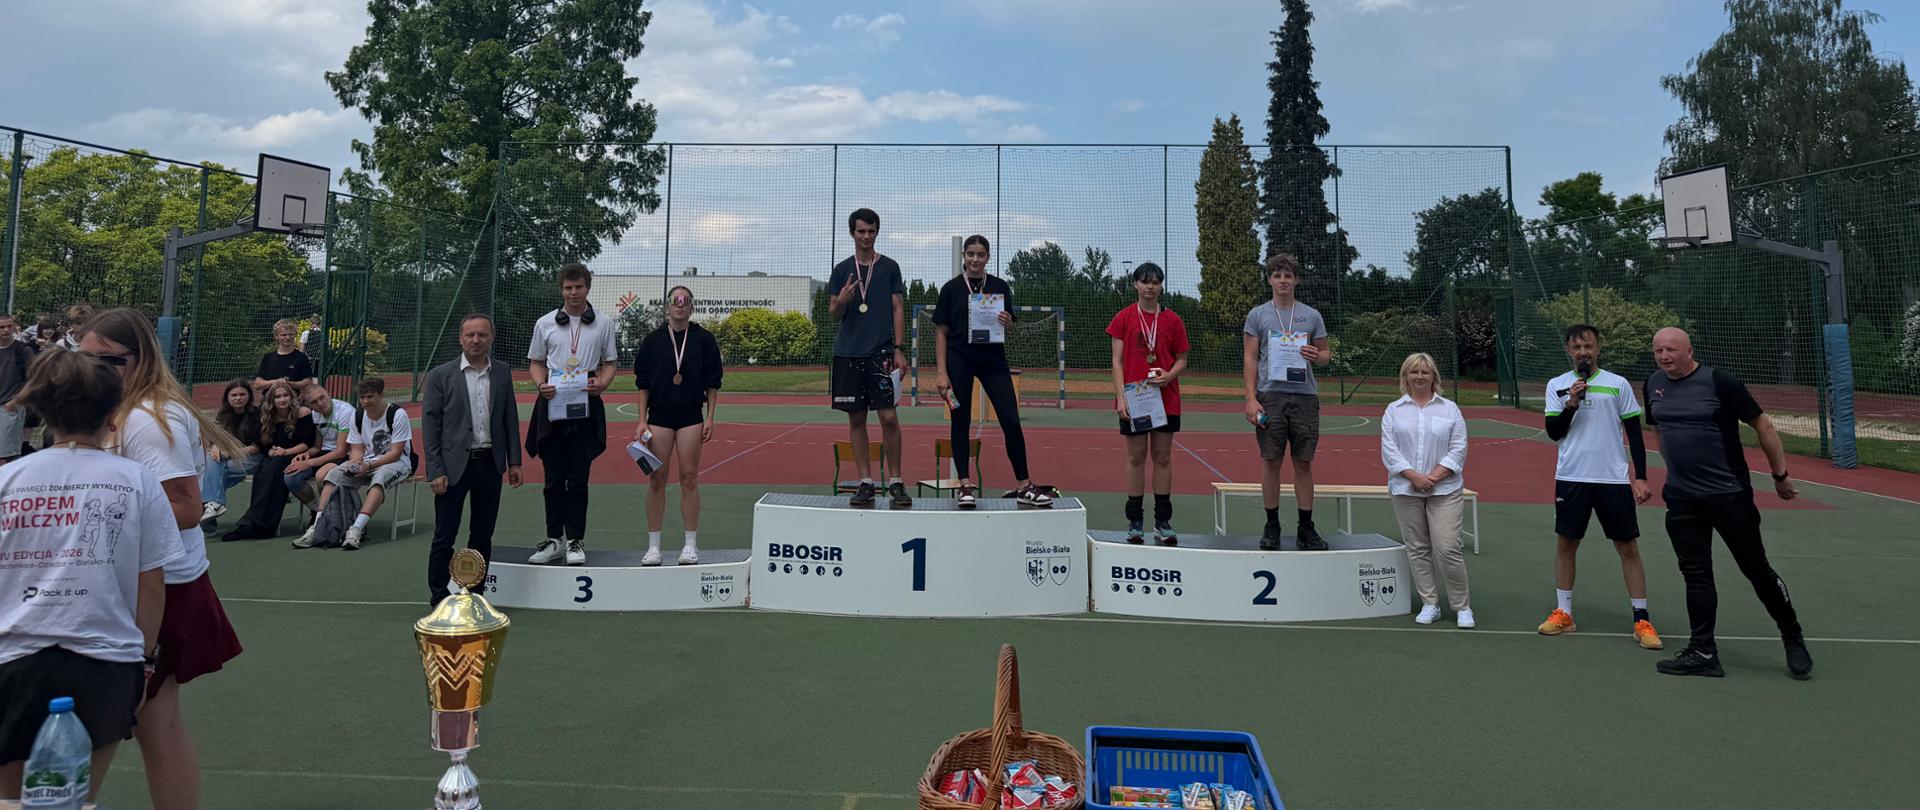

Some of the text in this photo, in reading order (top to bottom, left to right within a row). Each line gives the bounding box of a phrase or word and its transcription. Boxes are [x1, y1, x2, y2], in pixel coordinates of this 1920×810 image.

[1, 496, 75, 514] TROPEM
[1, 512, 80, 531] WILCZYM
[13, 550, 52, 560] EDYCJA
[60, 548, 83, 558] 2026
[769, 543, 843, 561] BBOSiR
[1025, 545, 1071, 554] Bielsko-Biała
[901, 538, 927, 591] 1
[1358, 567, 1396, 577] Bielsko-Biała
[1111, 566, 1182, 583] BBOSiR
[74, 588, 88, 597] up
[573, 576, 593, 603] 3
[1252, 570, 1278, 605] 2
